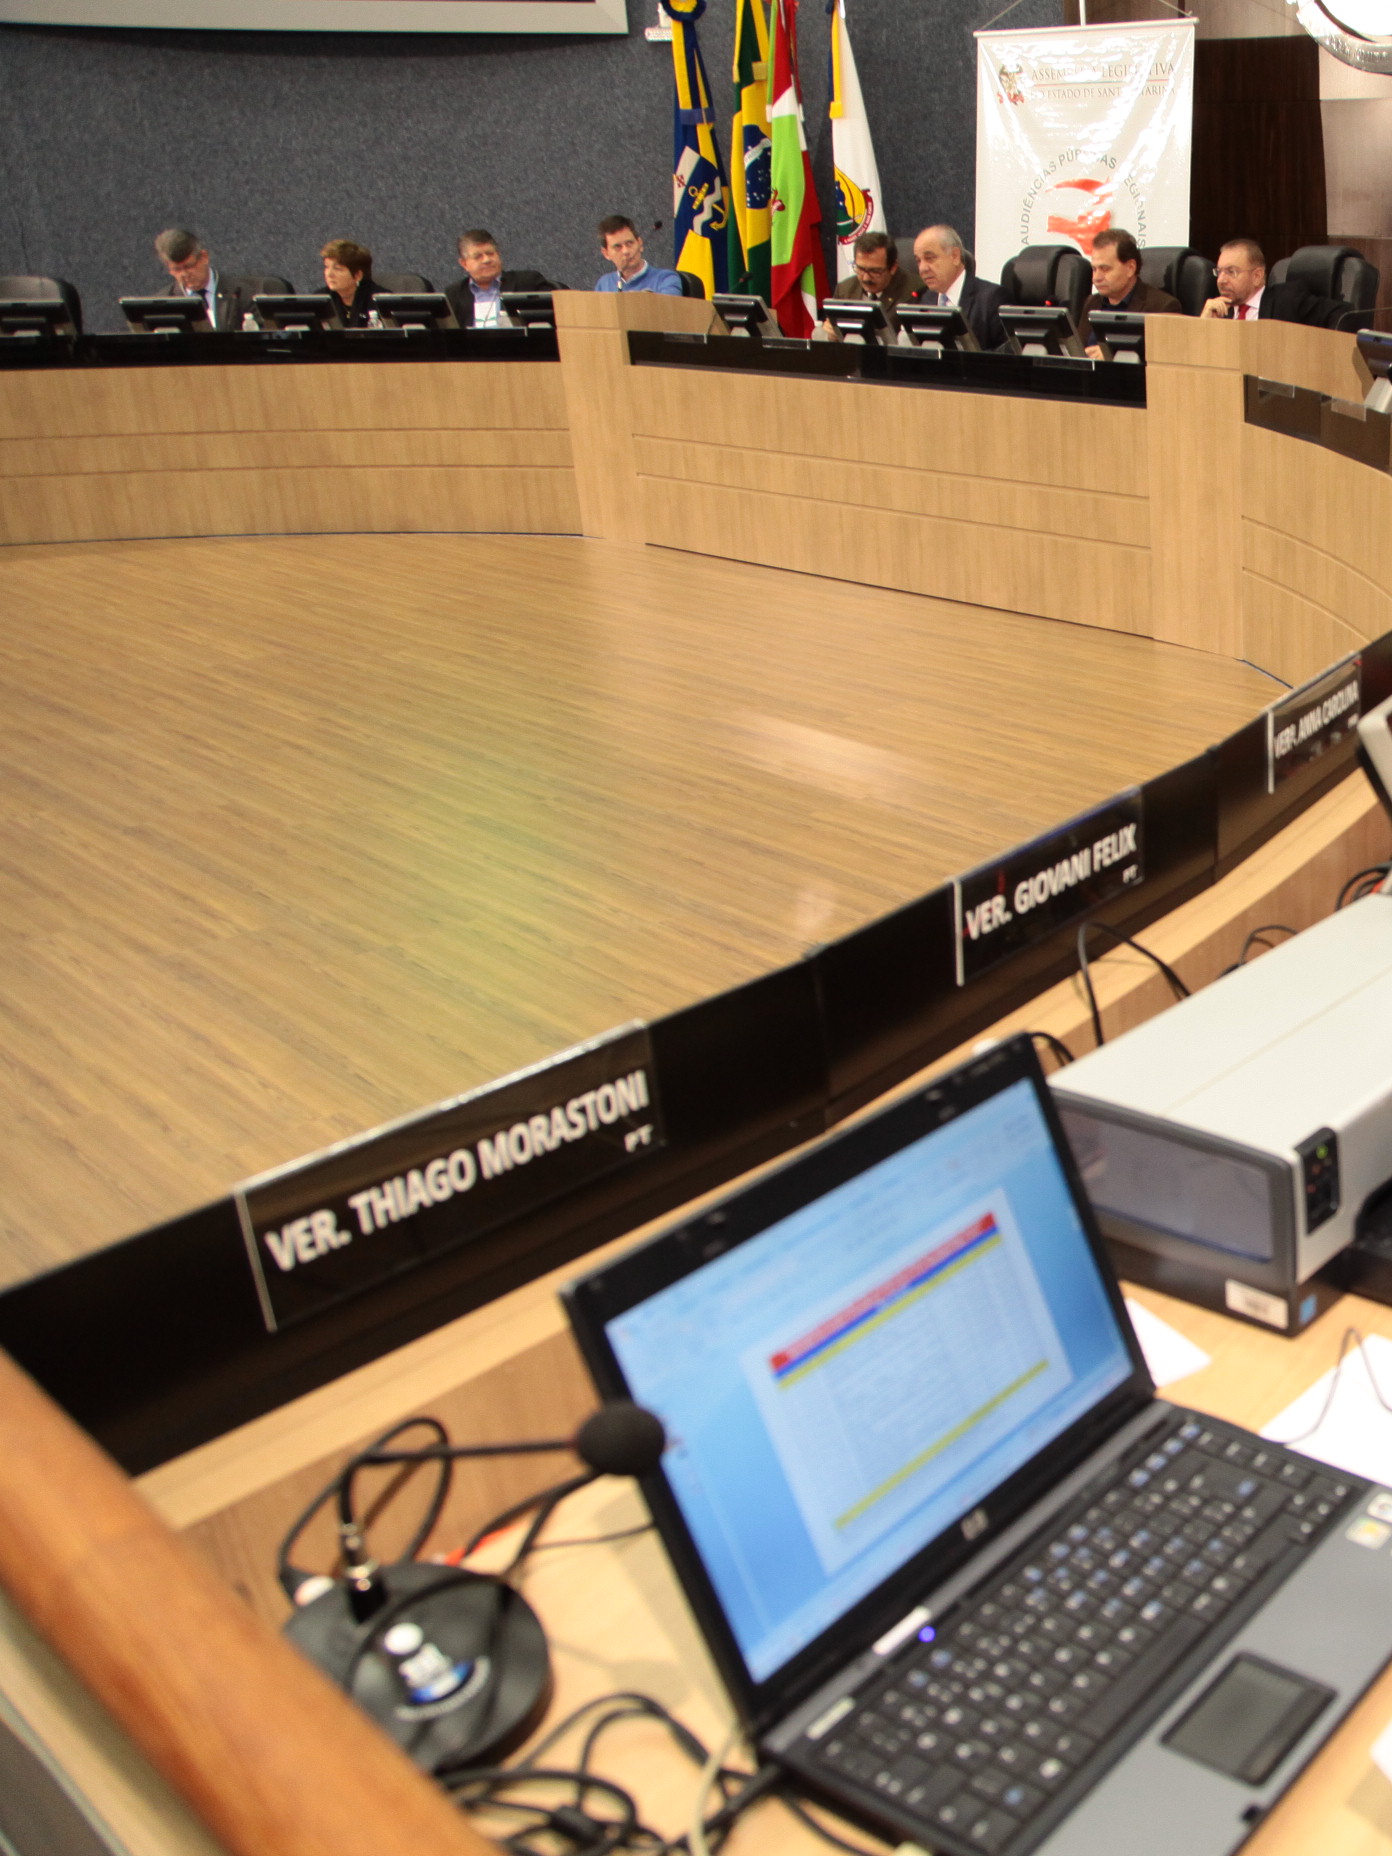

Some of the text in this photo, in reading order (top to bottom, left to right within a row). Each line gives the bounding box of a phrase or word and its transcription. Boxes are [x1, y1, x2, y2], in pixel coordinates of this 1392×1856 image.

[1047, 88, 1081, 99] ESTADO
[1083, 88, 1094, 98] DE
[1097, 86, 1127, 97] SANT
[965, 823, 1137, 940] VER. GIOVANI FELIX
[264, 1069, 649, 1272] VER. THIAGO MORASTONI
[624, 1124, 654, 1152] PT
